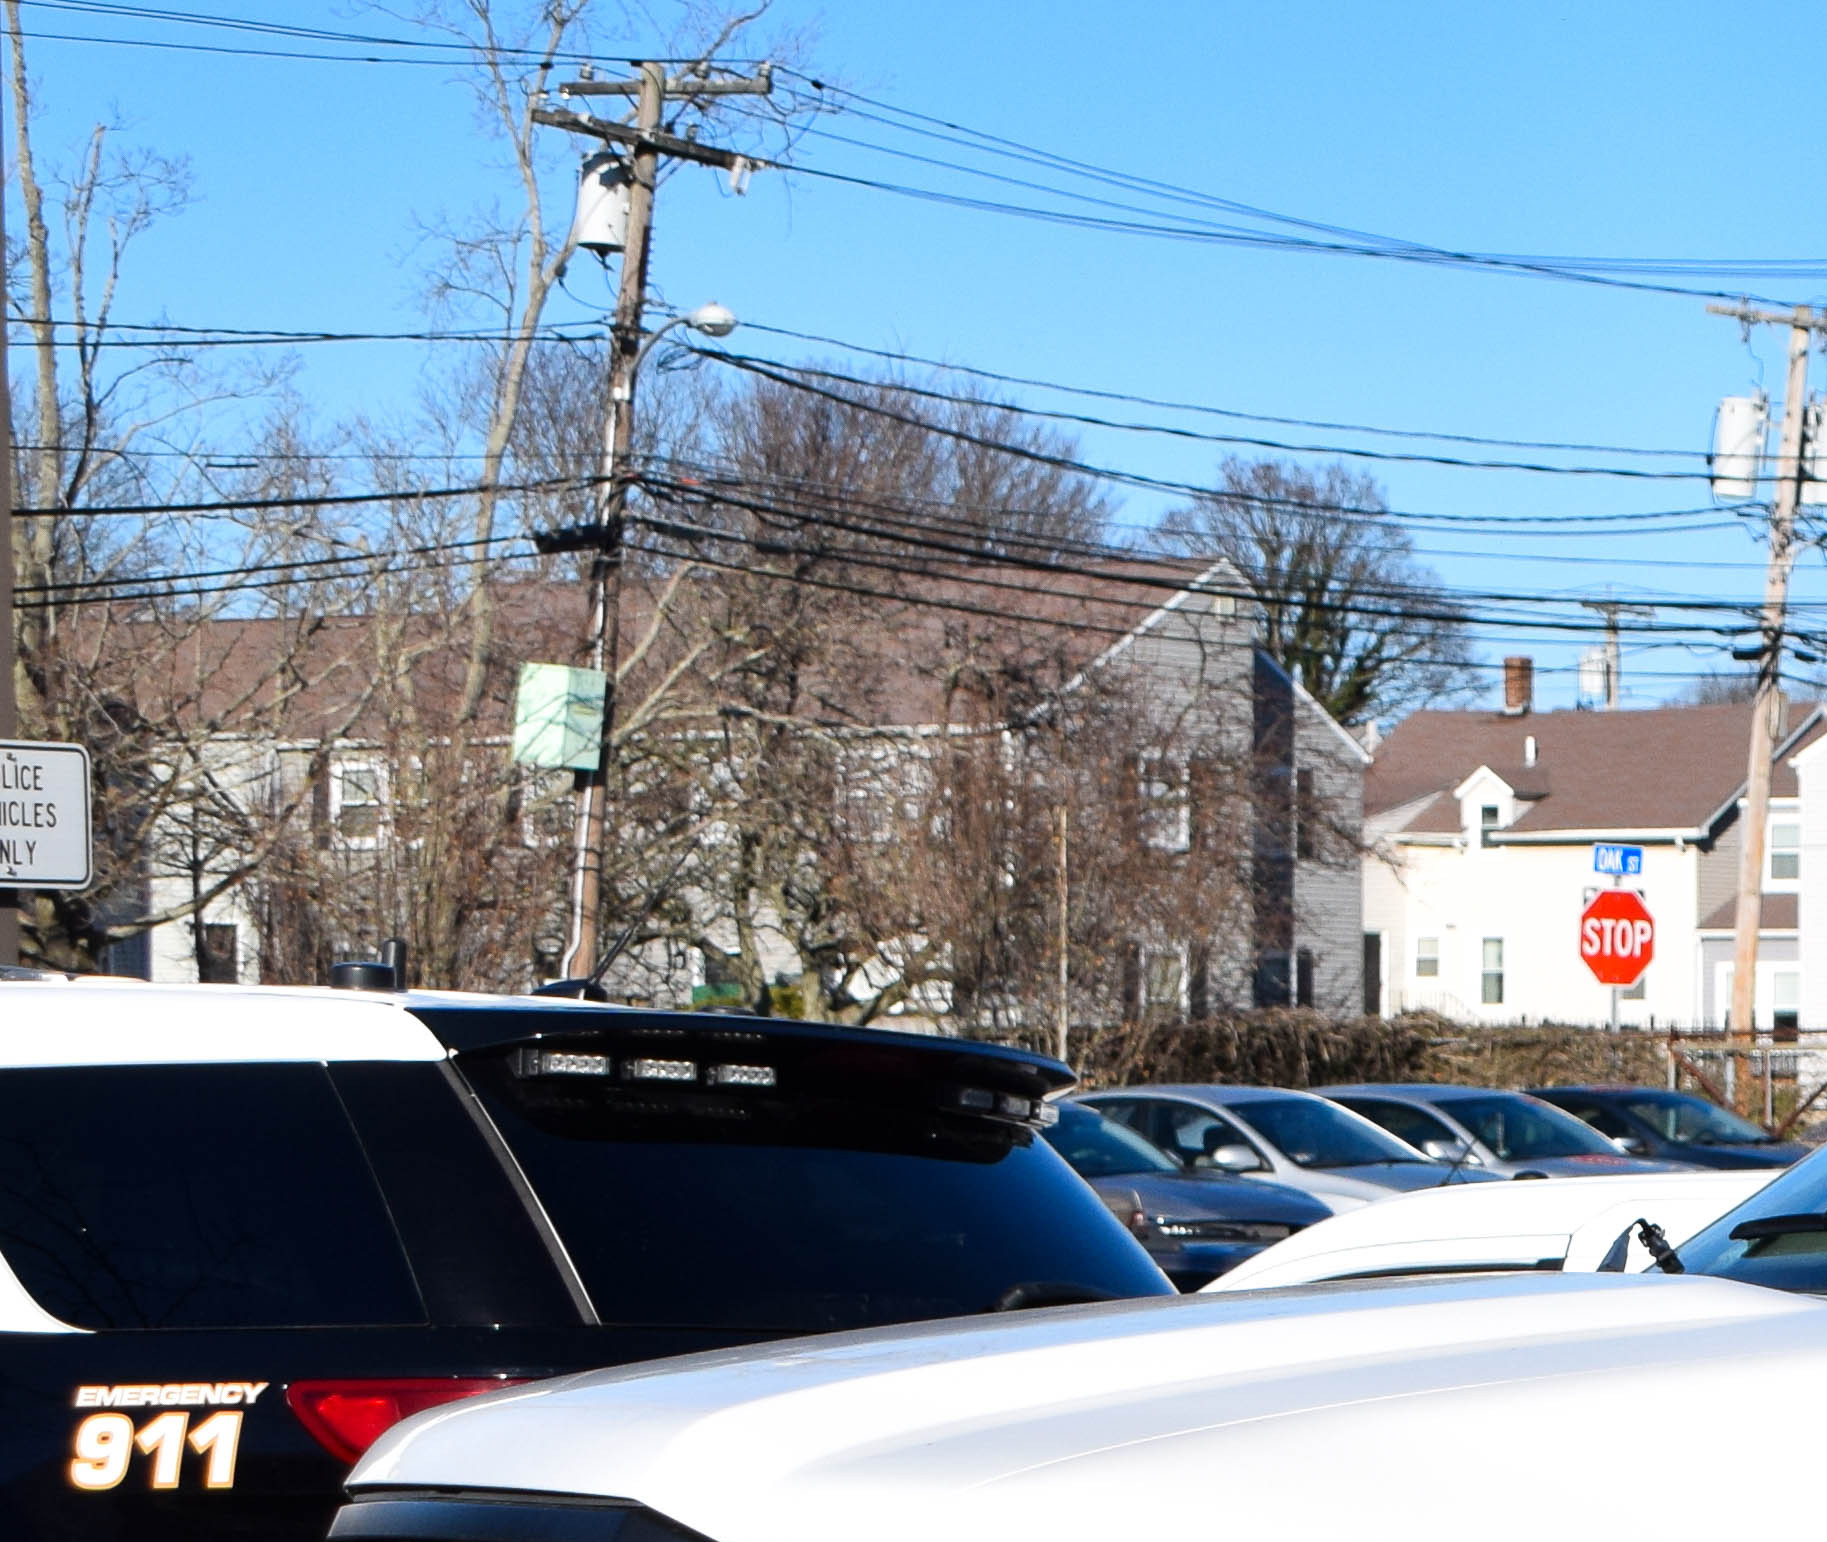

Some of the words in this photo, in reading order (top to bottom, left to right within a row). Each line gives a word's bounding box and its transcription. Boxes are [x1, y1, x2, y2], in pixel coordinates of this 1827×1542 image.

[1598, 848, 1622, 871] OAK
[1583, 917, 1652, 957] STOP
[76, 1382, 269, 1407] EMERGENCY
[71, 1411, 244, 1490] 911
